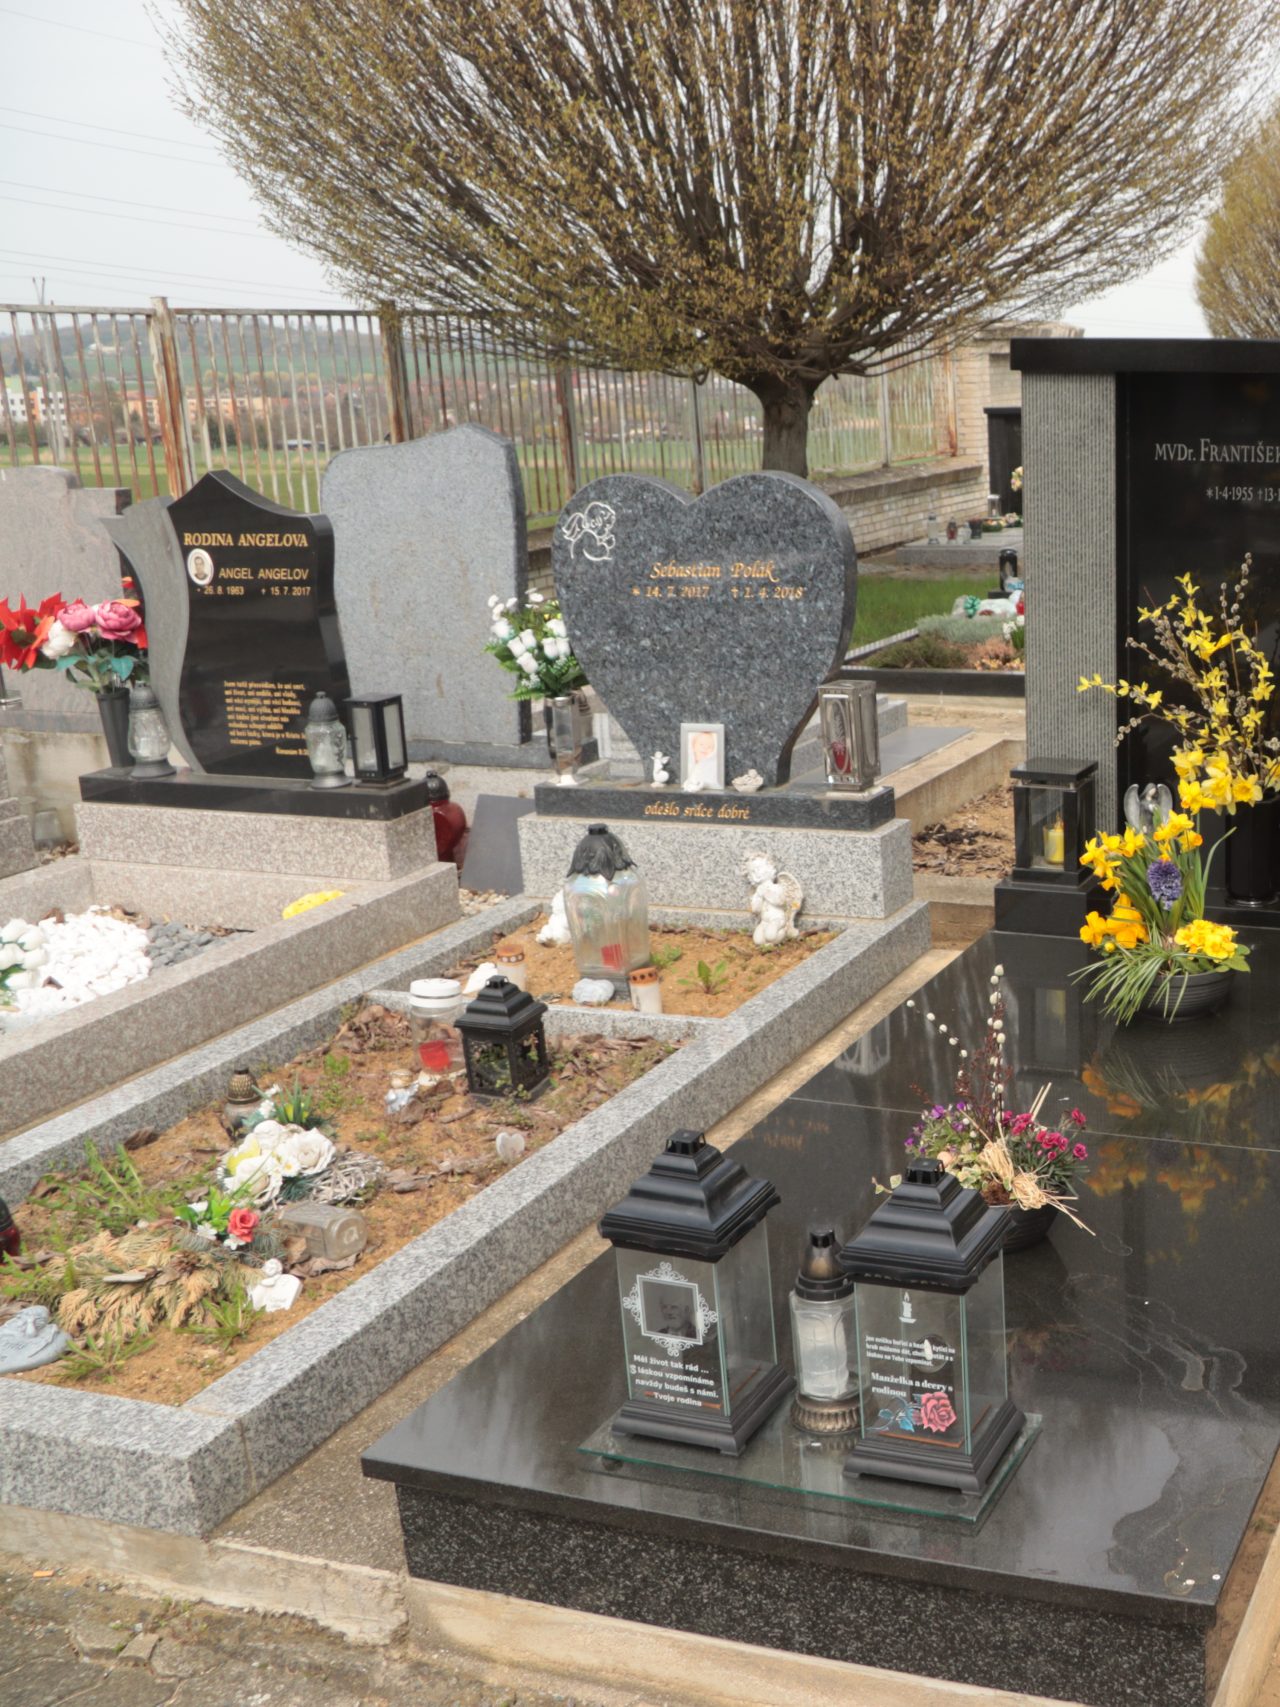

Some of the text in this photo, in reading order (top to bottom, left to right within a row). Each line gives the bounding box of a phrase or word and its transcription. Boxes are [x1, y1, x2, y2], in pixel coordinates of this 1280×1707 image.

[1154, 443, 1196, 461] MVDr.
[183, 533, 308, 547] RODINA ANGELOVA
[218, 568, 309, 580] ANGEL ANGELOV
[650, 559, 721, 579] Sebastian
[292, 588, 311, 596] 2017
[633, 1355, 648, 1363] Měl
[649, 1357, 669, 1366] život
[671, 1360, 684, 1369] tak
[685, 1363, 700, 1372] rád
[629, 1365, 715, 1386] S láskou vzpomínáme
[871, 1372, 914, 1386] Manželka
[921, 1380, 947, 1393] dcery
[635, 1379, 663, 1389] navždy
[664, 1383, 689, 1393] budeš
[696, 1389, 719, 1399] námi.
[871, 1386, 908, 1398] rodinou
[654, 1392, 703, 1407] Tvoje rodina
